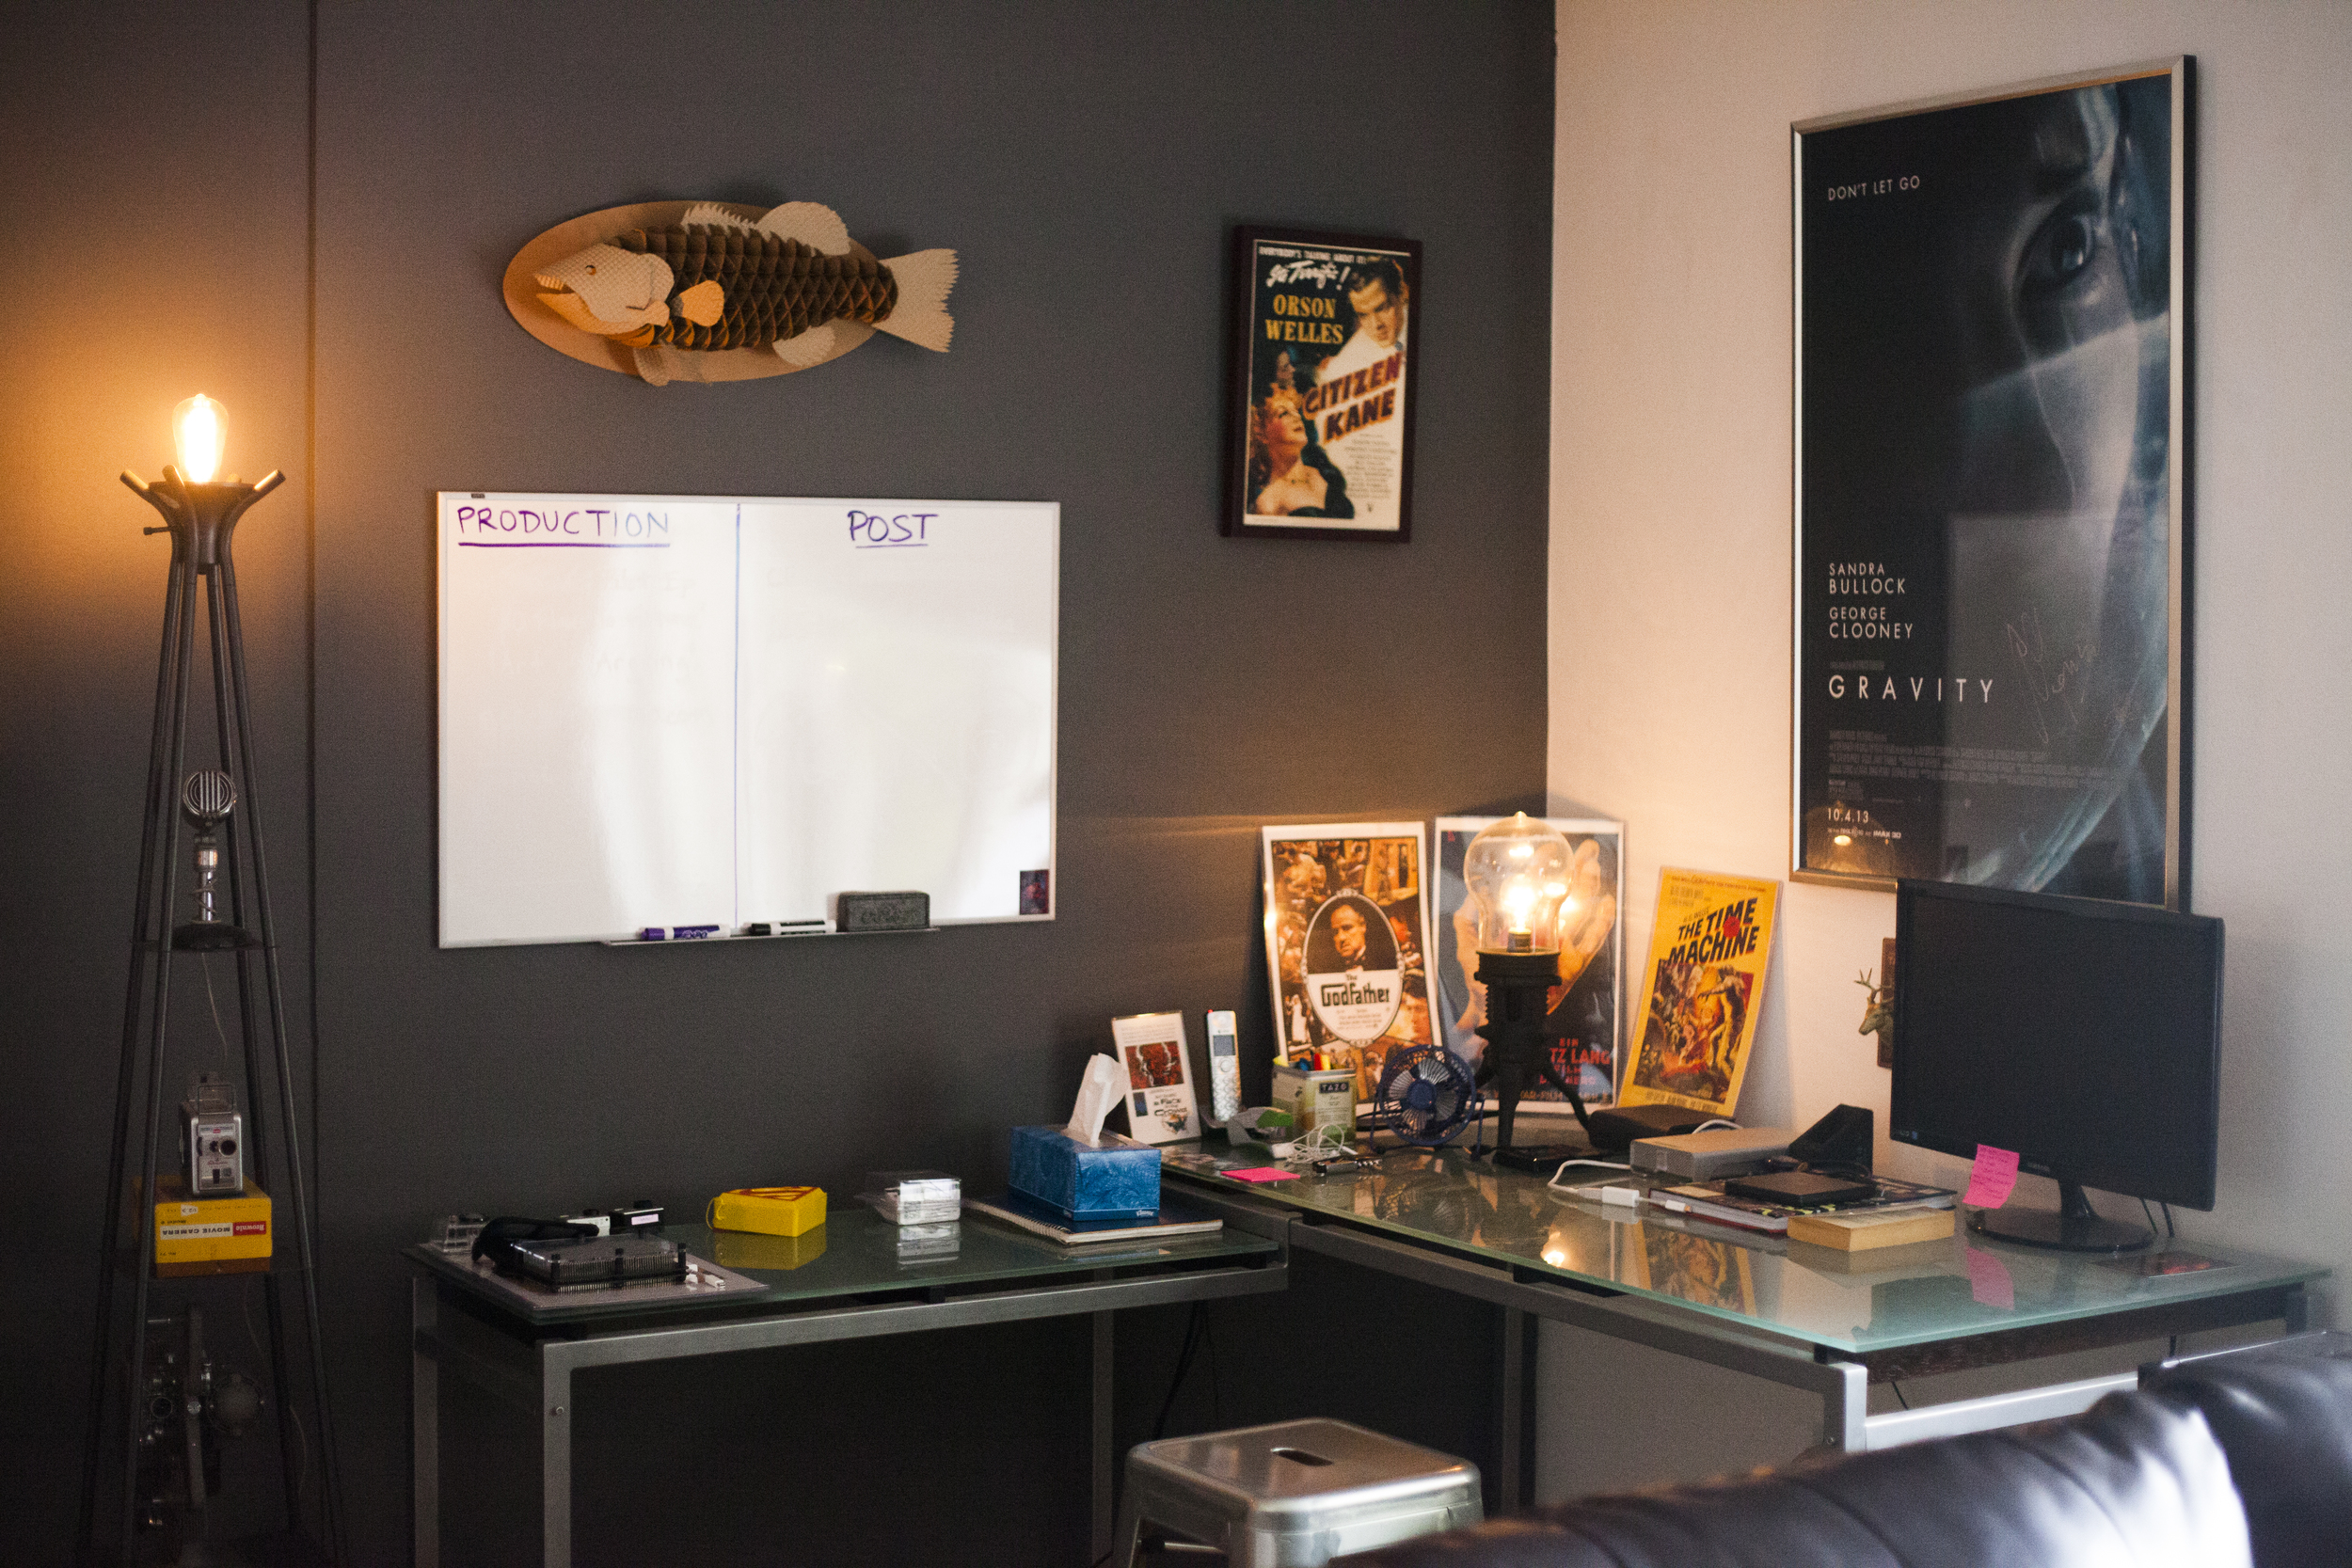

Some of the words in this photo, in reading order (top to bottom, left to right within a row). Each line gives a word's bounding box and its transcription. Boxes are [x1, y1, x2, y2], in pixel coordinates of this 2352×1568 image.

[1828, 182, 1867, 201] DON'T
[1873, 179, 1894, 195] LET
[1899, 175, 1921, 191] GO
[1273, 293, 1337, 320] ORSON
[1264, 319, 1343, 345] WELLES
[1302, 350, 1404, 420] CITIZEN
[1323, 387, 1398, 445] KANE
[457, 506, 670, 537] PRODUCTION
[848, 511, 939, 543] POST
[1829, 562, 1885, 577] SANDRA
[1829, 578, 1907, 594] BULLOCK
[1829, 607, 1886, 621] GEORGE
[1829, 623, 1914, 640] CLOONEY
[1828, 674, 1994, 704] GRAVITY
[1827, 807, 1869, 824] 10.4.13
[1677, 918, 1704, 942] THE
[1706, 897, 1758, 934] TIME
[1667, 926, 1760, 967] MACHINE
[1345, 973, 1358, 981] The
[1321, 982, 1391, 1007] Godfather
[1559, 1037, 1579, 1047] EIN
[1571, 1048, 1611, 1065] LANG
[1321, 1083, 1347, 1092] TAZO
[235, 1224, 265, 1232] Brownie
